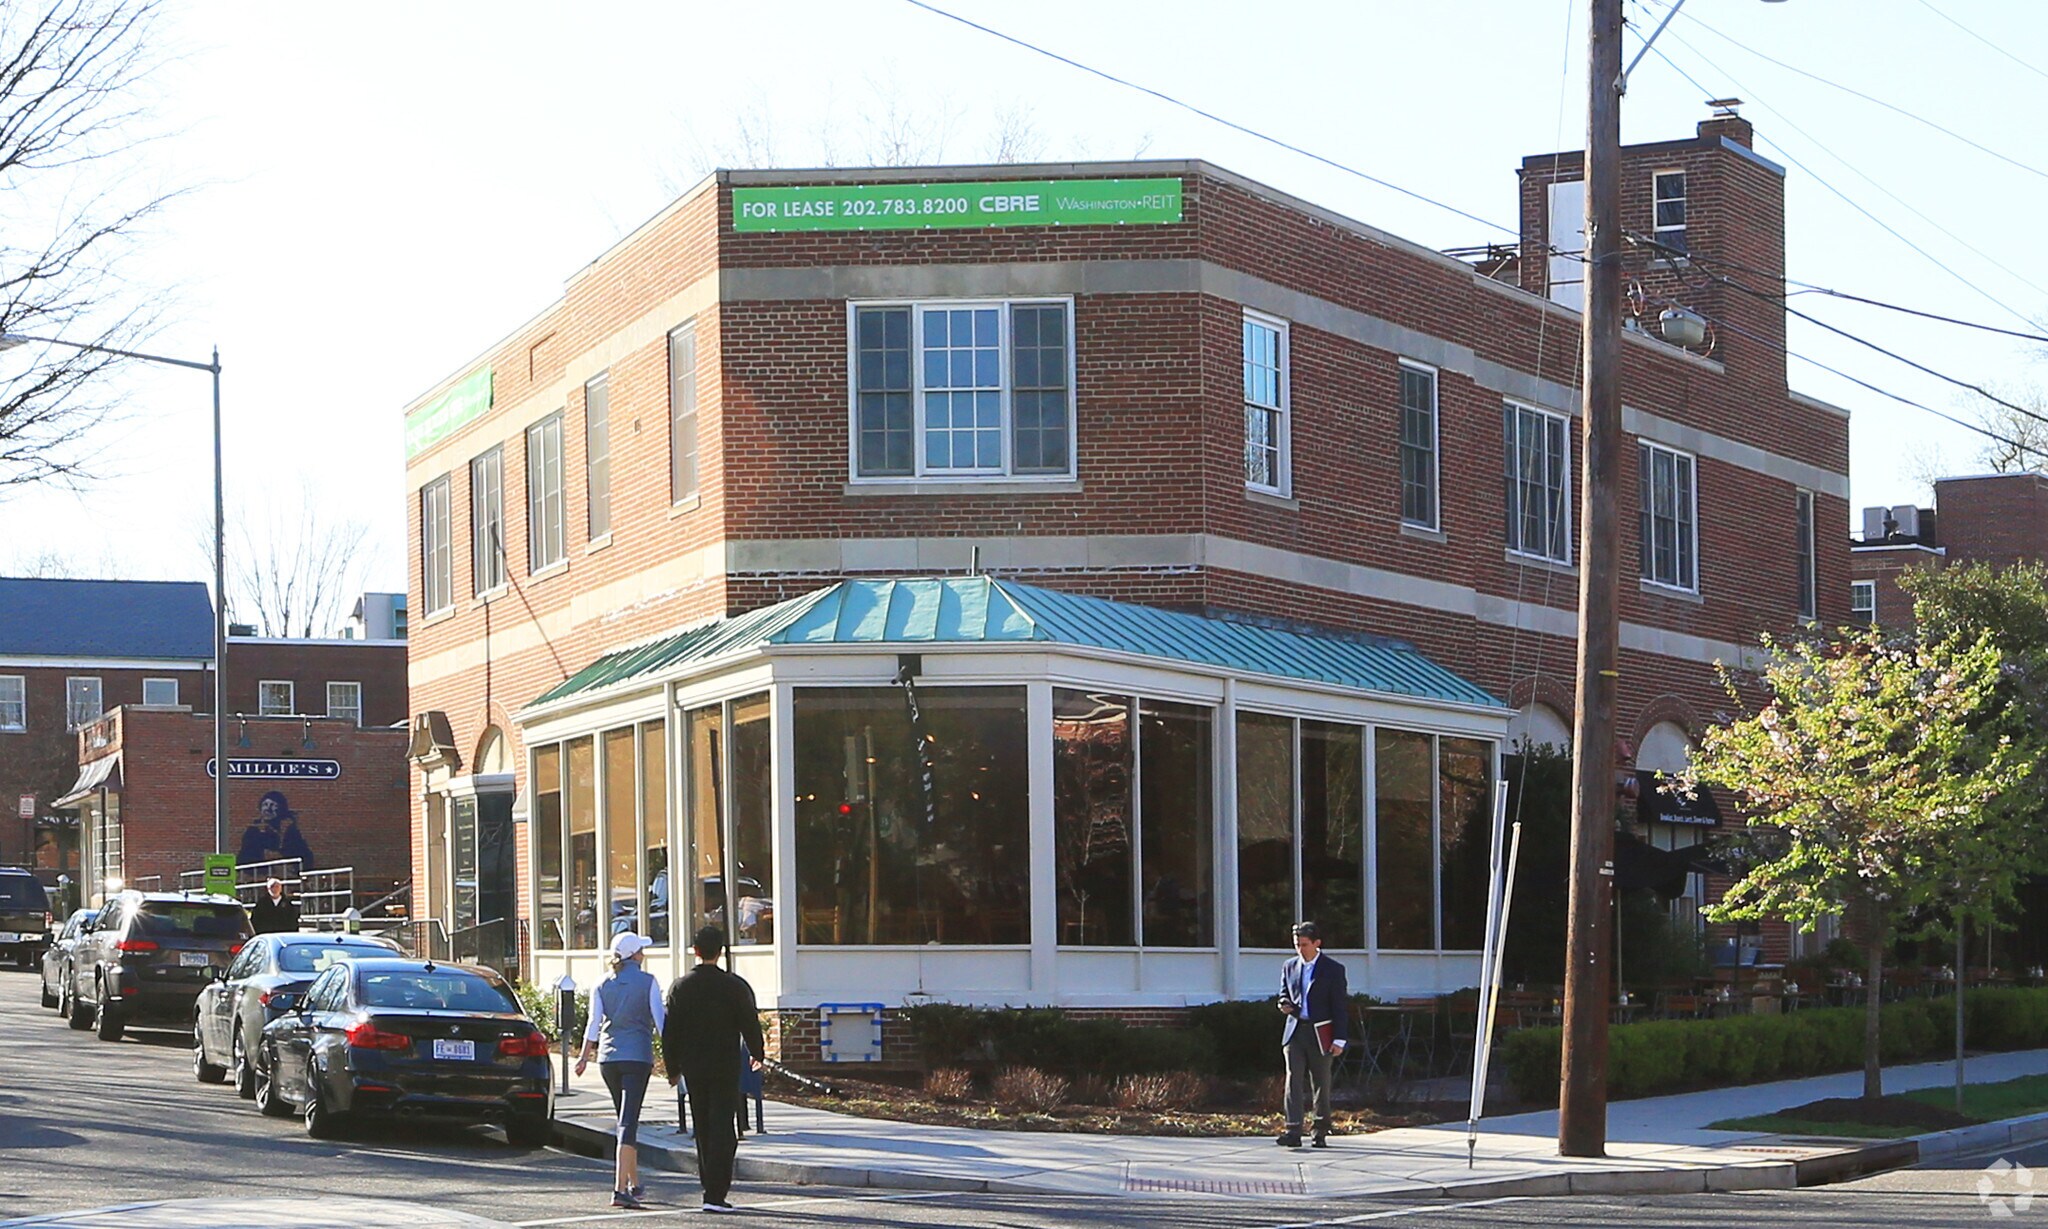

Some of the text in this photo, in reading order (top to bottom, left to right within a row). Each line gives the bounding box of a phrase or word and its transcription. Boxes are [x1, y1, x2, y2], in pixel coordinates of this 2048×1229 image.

[743, 202, 777, 218] FOR
[784, 200, 835, 217] LEASE
[842, 197, 968, 216] 202.783.8200
[978, 195, 1040, 212] CBRE
[228, 763, 319, 774] MILLIE'S
